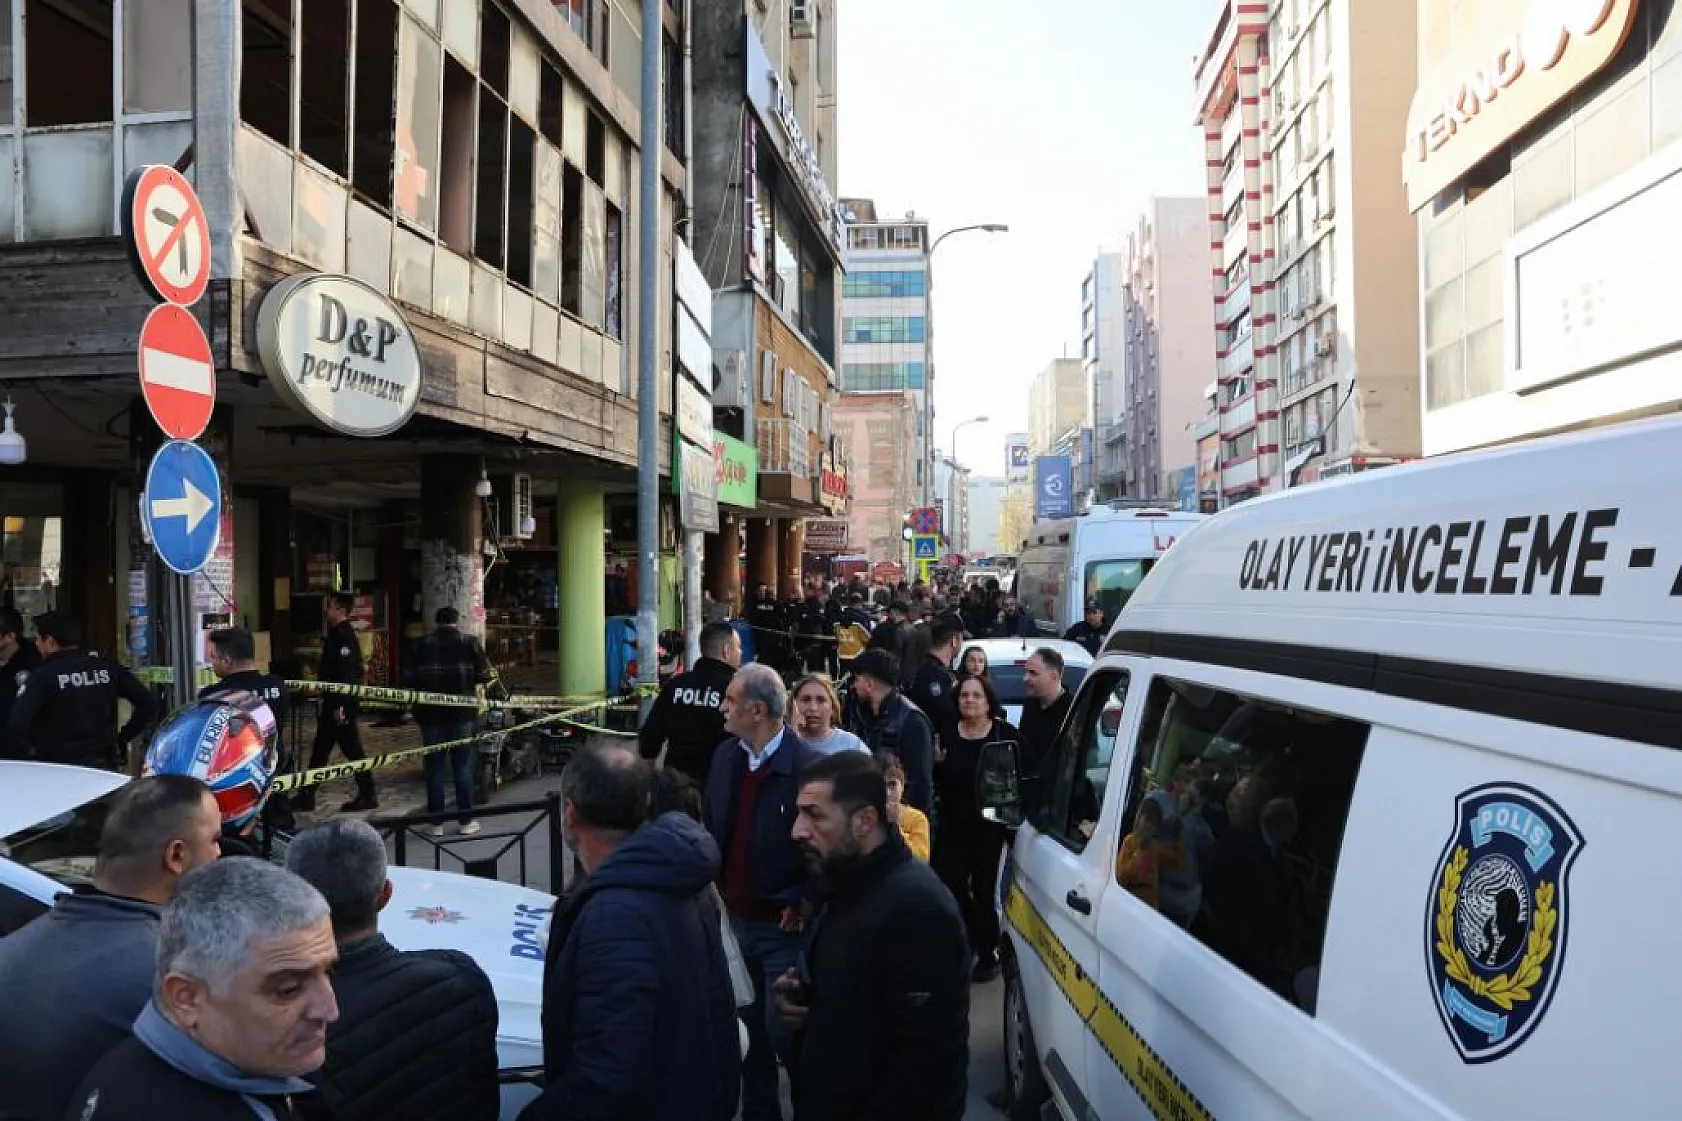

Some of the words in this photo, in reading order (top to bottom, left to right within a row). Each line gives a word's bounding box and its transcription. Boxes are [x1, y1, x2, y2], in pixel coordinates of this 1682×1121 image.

[316, 293, 398, 364] D&P
[297, 352, 406, 404] perfumum
[1239, 535, 1306, 591] OLAY
[672, 685, 720, 708] POLİS
[1480, 807, 1545, 846] POLİS
